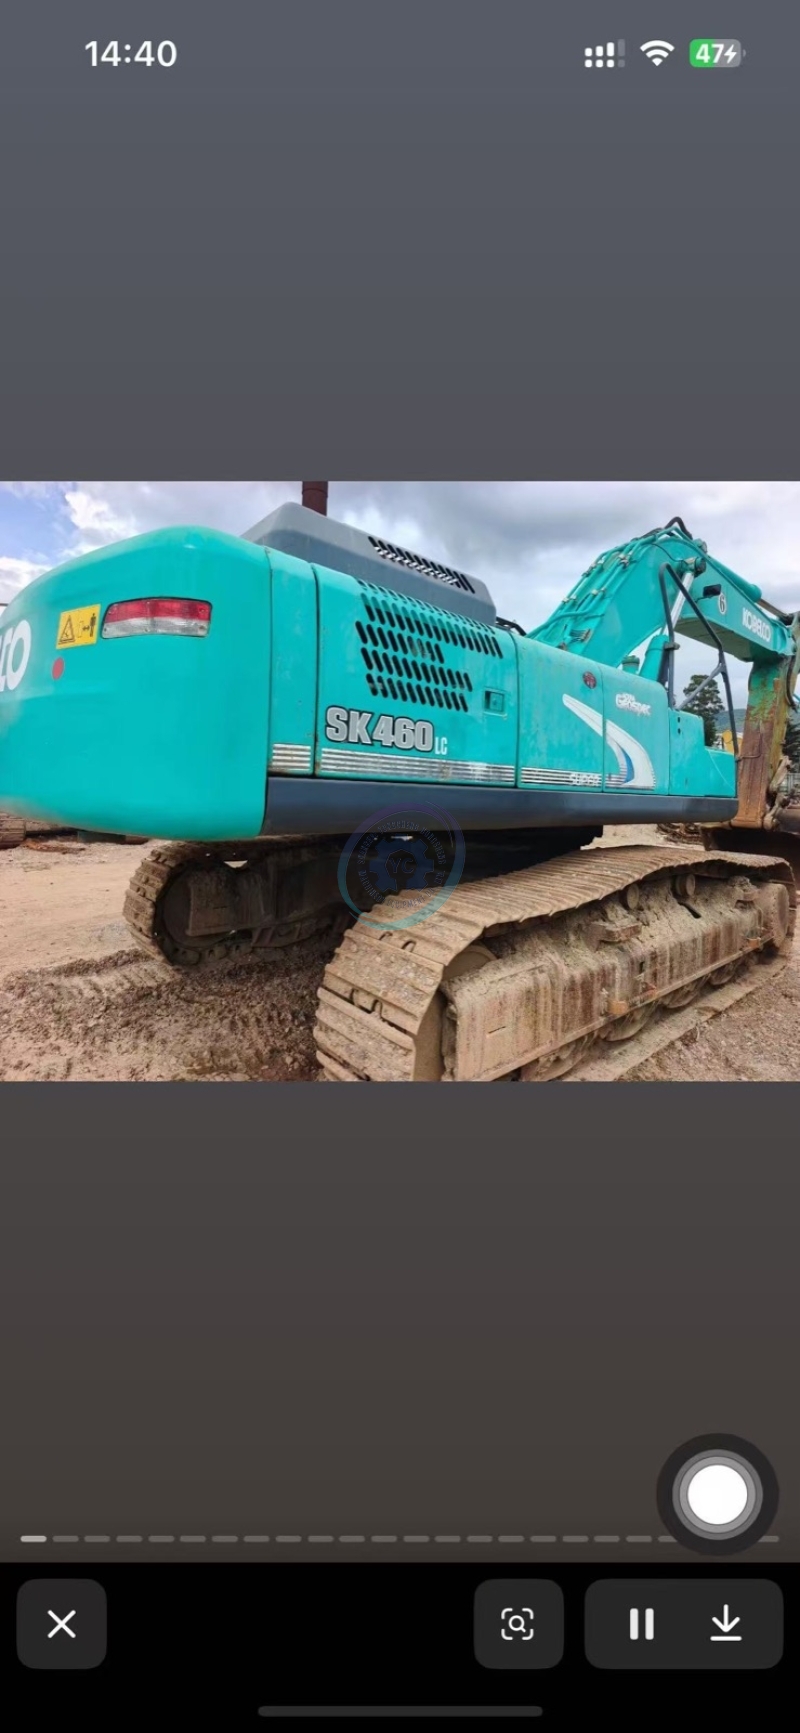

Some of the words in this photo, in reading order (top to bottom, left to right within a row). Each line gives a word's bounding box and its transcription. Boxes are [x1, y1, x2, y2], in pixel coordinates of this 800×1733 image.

[84, 40, 178, 67] 14:40
[695, 43, 725, 64] 47
[325, 705, 434, 753] SK460
[435, 737, 448, 755] LC
